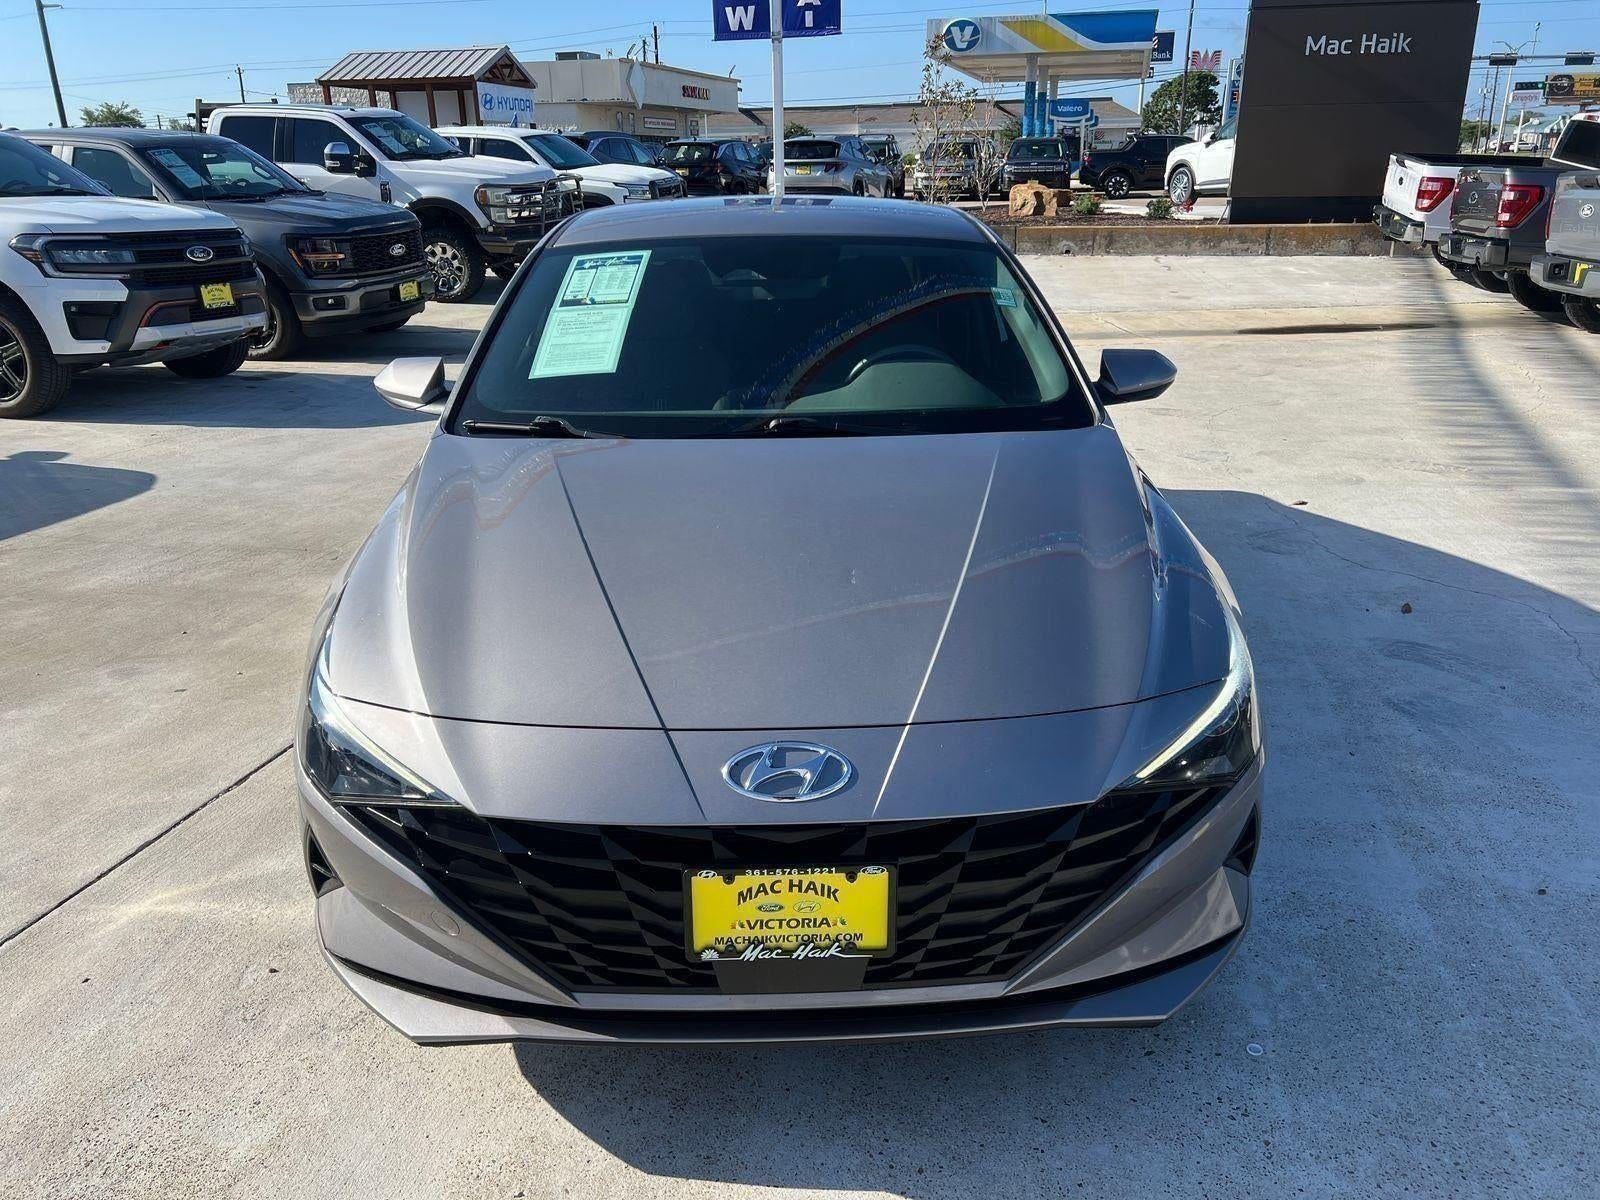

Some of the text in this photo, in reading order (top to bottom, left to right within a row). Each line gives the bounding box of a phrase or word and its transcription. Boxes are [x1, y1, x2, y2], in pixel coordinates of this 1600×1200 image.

[1305, 33, 1412, 55] Mac Haik
[1152, 51, 1171, 59] Bank
[497, 96, 533, 112] HYUNDAI
[745, 867, 836, 876] 361-576-1221
[737, 879, 839, 906] MAC HAIK
[745, 917, 831, 930] VICTORIA
[714, 933, 863, 946] MACHAIKVICTORIA.COM
[738, 942, 846, 962] Mac Haik
